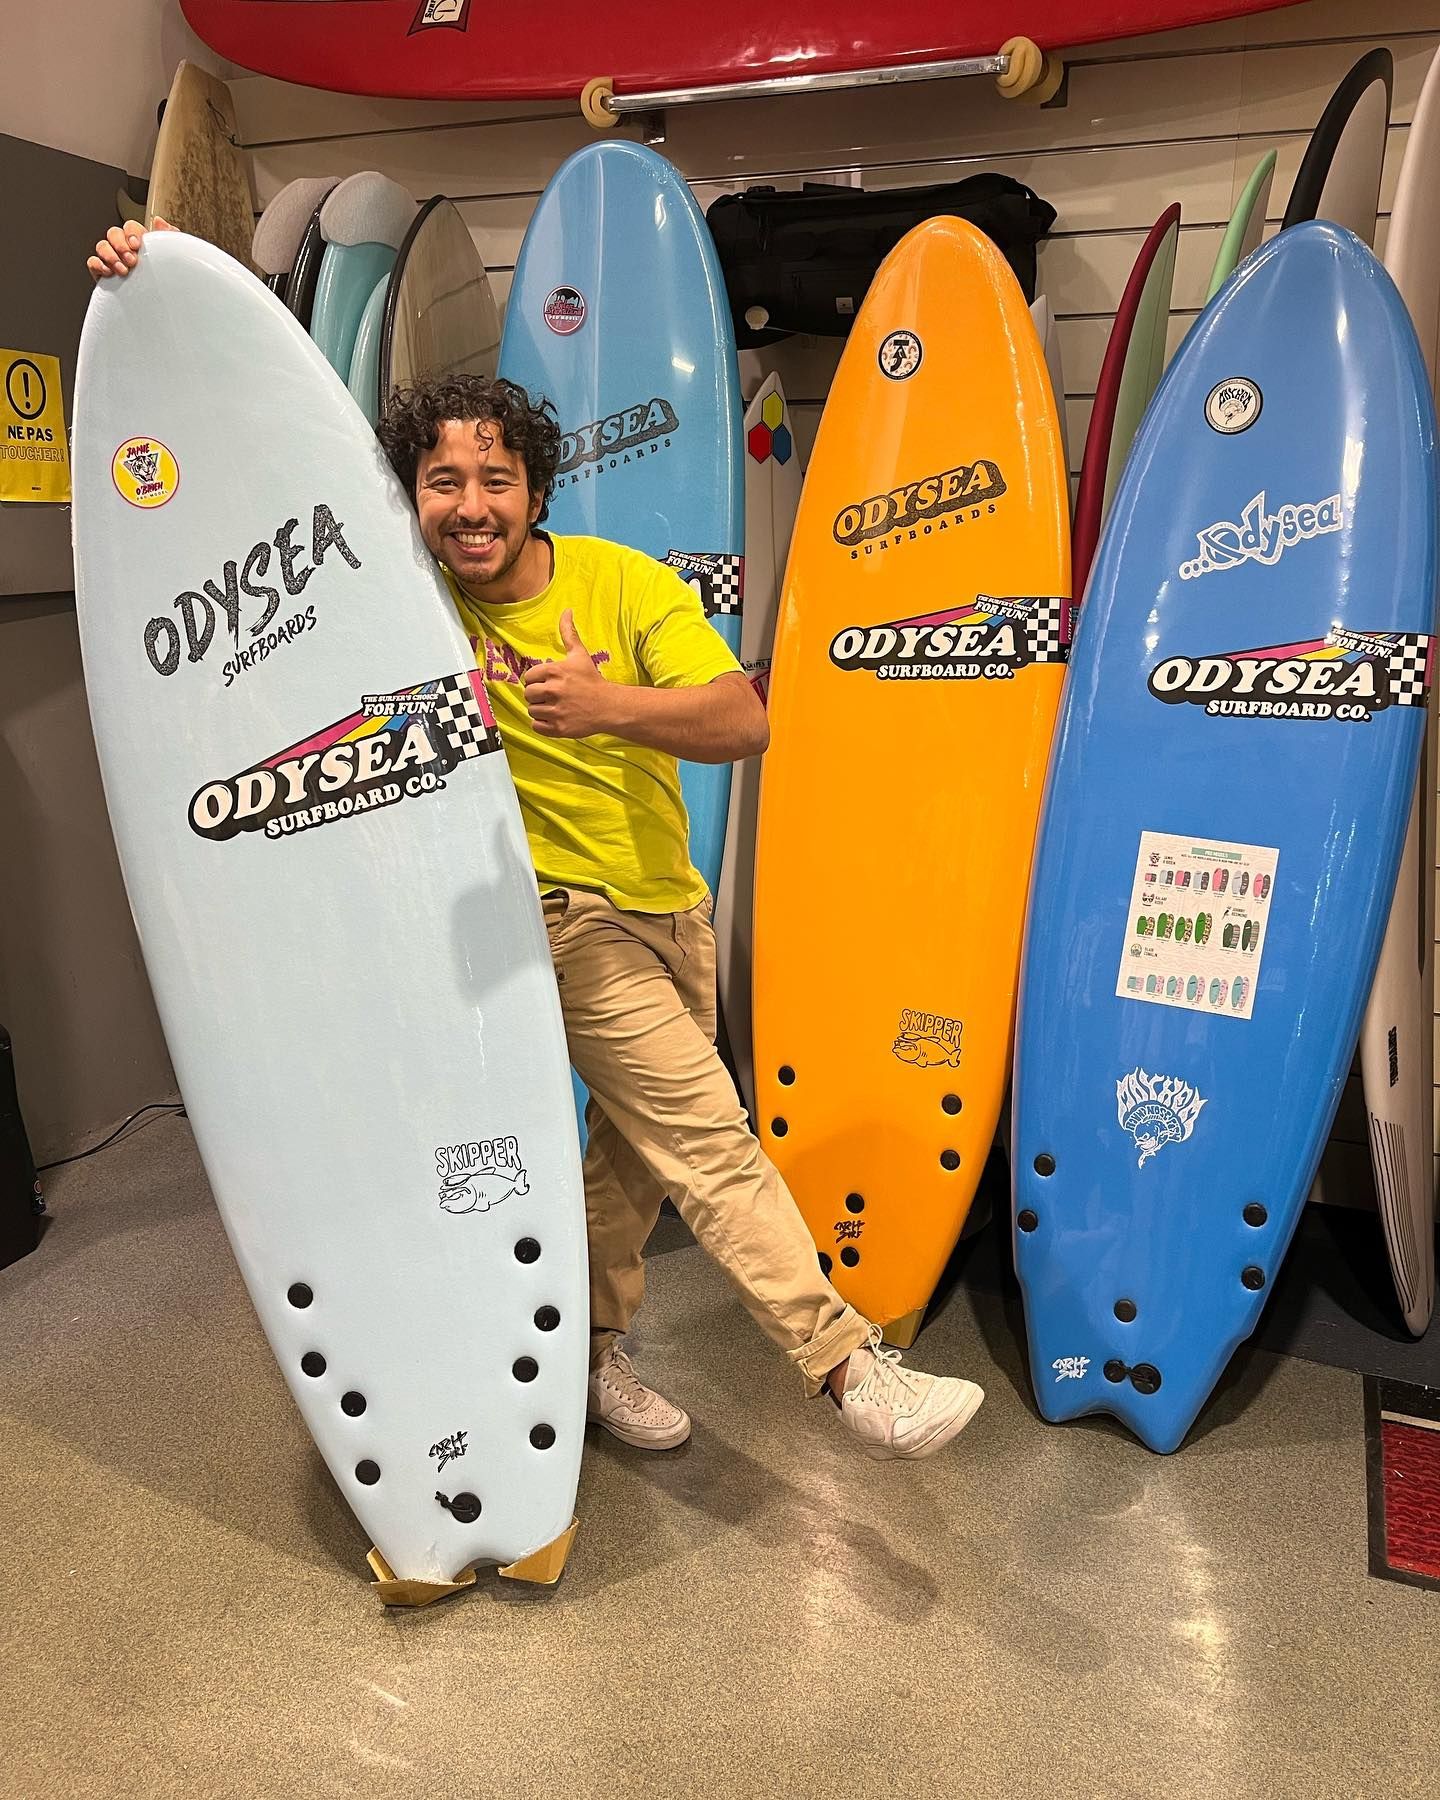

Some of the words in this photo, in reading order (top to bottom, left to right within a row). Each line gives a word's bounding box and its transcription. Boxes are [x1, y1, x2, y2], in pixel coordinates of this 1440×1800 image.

[7, 425, 25, 440] NE
[26, 427, 54, 442] PAS
[126, 442, 150, 459] JAMIE
[558, 399, 675, 468] DYSEA
[557, 438, 671, 489] URFBOARDS
[149, 490, 169, 498] MODEL
[834, 462, 1001, 543] ODYSEA
[850, 504, 997, 560] SURFBOARDS
[665, 555, 689, 569] FOR
[686, 560, 715, 576] FUN!
[144, 504, 362, 676] ODYSEA
[974, 600, 1000, 615] FOR
[999, 606, 1029, 621] FUN!
[222, 605, 318, 688] SURFBOARDS
[833, 624, 1017, 660] ODYSEA
[1328, 634, 1356, 650] FOR
[1355, 641, 1394, 659] FUN!
[877, 663, 982, 678] SURFBOARD
[984, 663, 1013, 678] CO.
[1151, 658, 1376, 697] ODYSEA
[362, 702, 395, 717] FOR
[396, 700, 436, 715] FUN!
[379, 694, 412, 703] SURFER'S
[412, 692, 440, 701] CHOICE
[1206, 699, 1332, 718] SURFBOARD
[1335, 703, 1370, 720] CO.
[192, 723, 438, 829] ODYSEA
[266, 782, 401, 838] SURFBOARD
[405, 772, 444, 795] CO.
[899, 1008, 963, 1049] SKIPPER
[434, 1135, 522, 1178] SKIPPER
